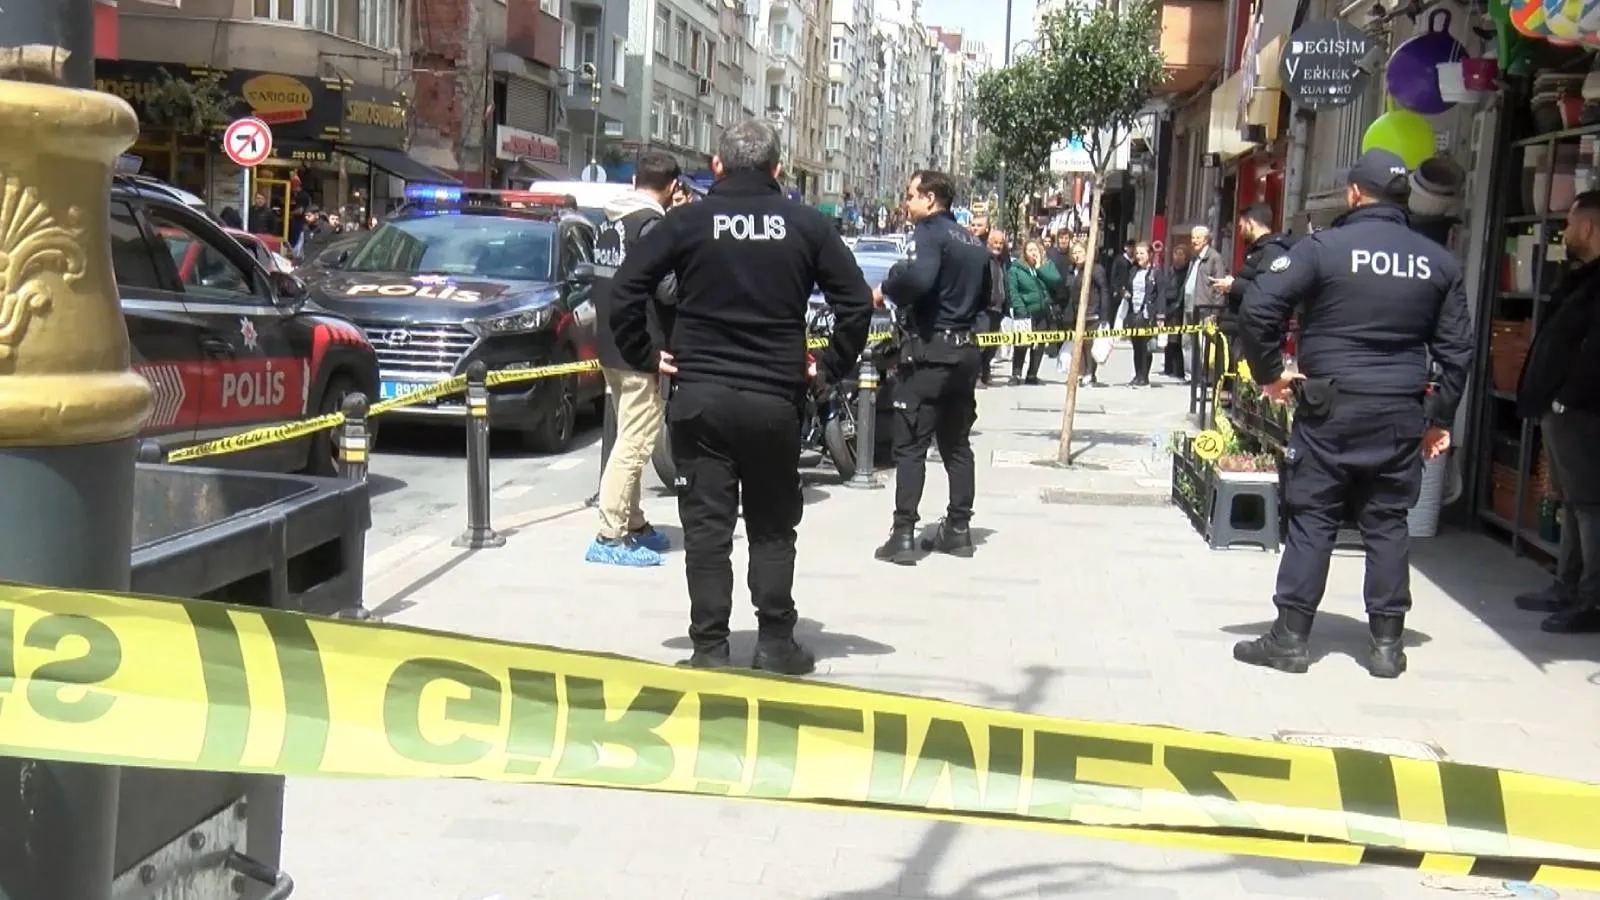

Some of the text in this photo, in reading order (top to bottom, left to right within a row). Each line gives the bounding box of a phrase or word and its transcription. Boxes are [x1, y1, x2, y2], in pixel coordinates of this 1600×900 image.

[1291, 38, 1365, 57] DEĞİŞİM
[1303, 67, 1350, 80] ERKEK
[713, 213, 787, 240] POLIS
[222, 370, 286, 408] POLİS
